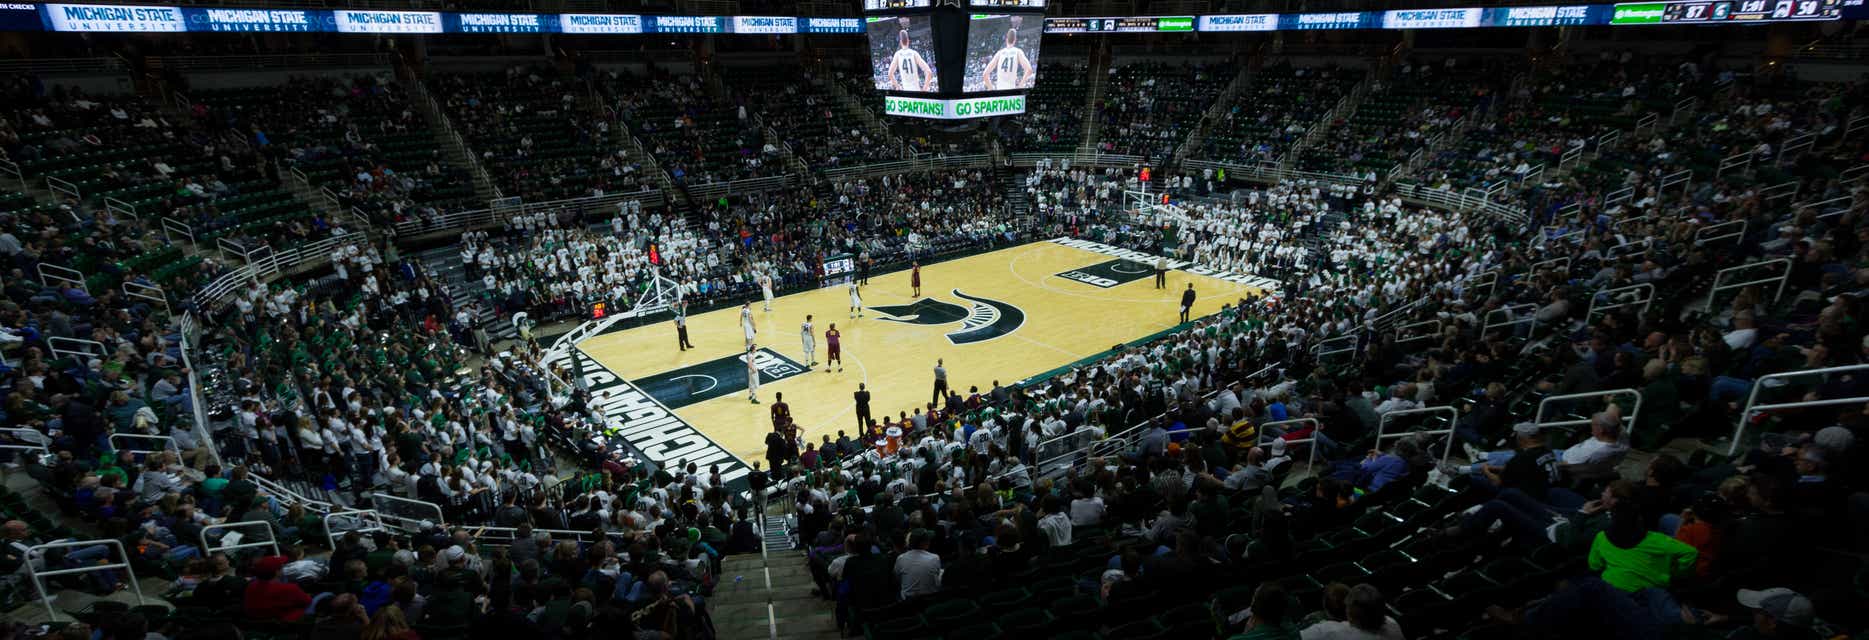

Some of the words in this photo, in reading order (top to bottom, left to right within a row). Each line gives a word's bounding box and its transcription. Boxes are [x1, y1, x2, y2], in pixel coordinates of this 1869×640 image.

[63, 6, 133, 21] MICHIGAN
[135, 8, 175, 22] STATE
[207, 9, 270, 23] MICHIGAN
[270, 11, 309, 24] STATE
[347, 12, 400, 24] MICHIGAN
[404, 14, 435, 24] STATE
[1396, 11, 1438, 21] MICHIGAN
[1438, 10, 1466, 20] STATE
[1508, 7, 1557, 19] MICHIGAN
[1556, 6, 1588, 18] STATE
[1685, 5, 1706, 19] 87
[459, 14, 510, 26] MICHIGAN
[510, 15, 539, 26] STATE
[570, 15, 611, 26] MICHIGAN
[613, 16, 637, 26] STATE
[656, 16, 694, 26] MICHIGAN
[695, 16, 717, 26] STATE
[741, 18, 774, 27] MICHIGAN
[775, 18, 793, 27] STATE
[809, 18, 840, 27] MICHIGAN
[840, 18, 860, 28] STATE
[1209, 16, 1244, 25] MICHIGAN
[1244, 16, 1266, 24] STATE
[1299, 13, 1336, 24] MICHIGAN
[1336, 13, 1361, 23] STATE
[1506, 17, 1585, 26] UNIVERSITY
[69, 22, 177, 31] UNIVERSITY
[211, 23, 309, 31] UNIVERSITY
[902, 58, 914, 74] 41
[1000, 56, 1014, 73] 41
[885, 99, 896, 113] GO
[898, 100, 945, 116] SPARTANS!
[955, 102, 972, 116] GO
[974, 98, 1024, 115] SPARTANS!
[1048, 235, 1193, 271] MICHIGAN
[591, 382, 754, 485] MICHIGAN
